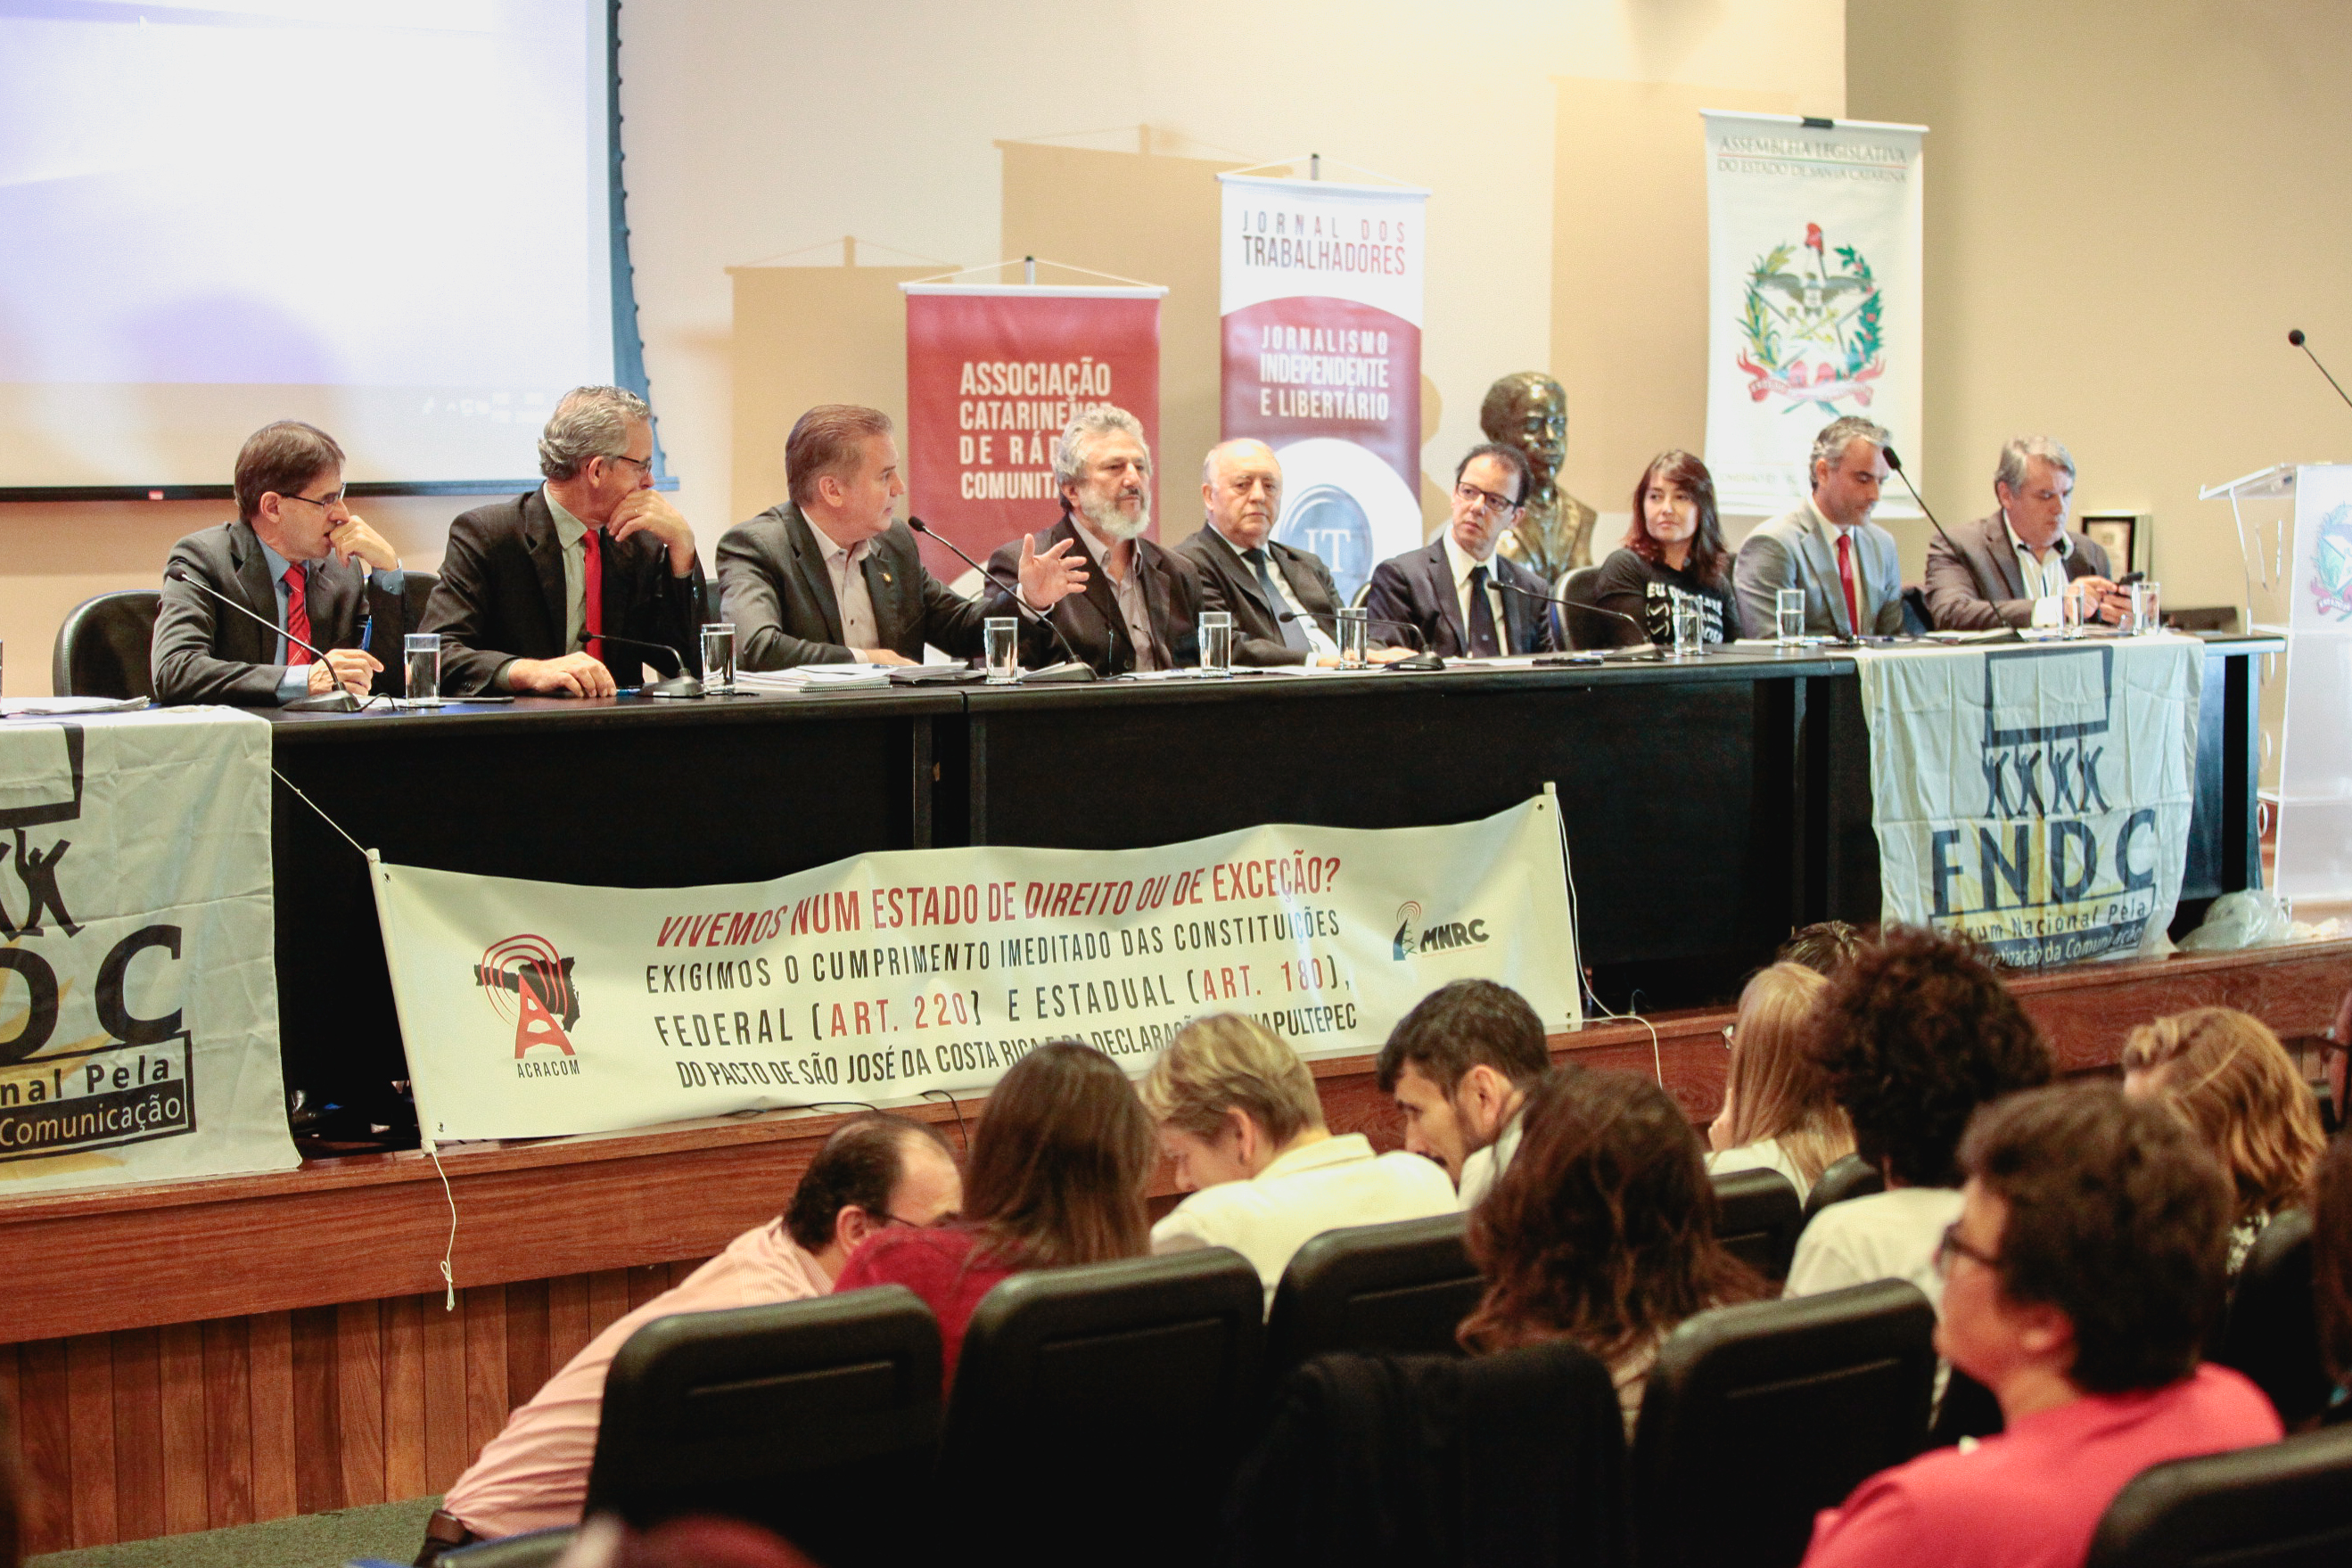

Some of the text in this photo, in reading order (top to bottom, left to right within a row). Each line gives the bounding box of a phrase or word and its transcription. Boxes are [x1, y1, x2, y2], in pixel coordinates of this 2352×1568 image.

[1242, 209, 1405, 243] JORNAL DOS
[1241, 234, 1406, 275] TRABALHADORES
[1262, 324, 1388, 356] JORNALISMO
[959, 357, 1112, 400] ASSOCIAÇÃO
[1259, 353, 1390, 389] INDEPENDENTE
[1260, 385, 1390, 422] E LIBERTÁRIO
[959, 429, 1061, 465] DE RÁD
[960, 471, 1060, 500] COMUNIT
[1932, 809, 2156, 917] FNDC
[656, 850, 1342, 948] VIVEMOS NUM ESTADO DE DIREITO OU DE EXCEÇÃO?
[2011, 912, 2097, 937] Nacional
[2108, 899, 2147, 923] Pela
[646, 905, 1341, 995] EXIGIMOS O CUMPRIMENTO IMEDITADO DAS CONSTITUIÇÕES
[1419, 918, 1490, 953] MNRC
[2045, 944, 2062, 964] da
[654, 1006, 794, 1049] FEDERAL
[1007, 988, 1021, 1022] E
[1036, 967, 1175, 1021] ESTADUAL
[674, 1059, 706, 1089] DO
[707, 1059, 773, 1088] PACTO
[772, 1058, 801, 1087] DE
[798, 1051, 839, 1087] SÃO
[846, 1044, 896, 1085] JOSÉ
[901, 1049, 933, 1079] DA
[935, 1039, 999, 1074] COSTA
[1248, 1002, 1357, 1037] APULTEPEC
[86, 1055, 169, 1094] Pela
[516, 1059, 580, 1079] ACRACOM
[0, 1094, 181, 1146] Comunicação
